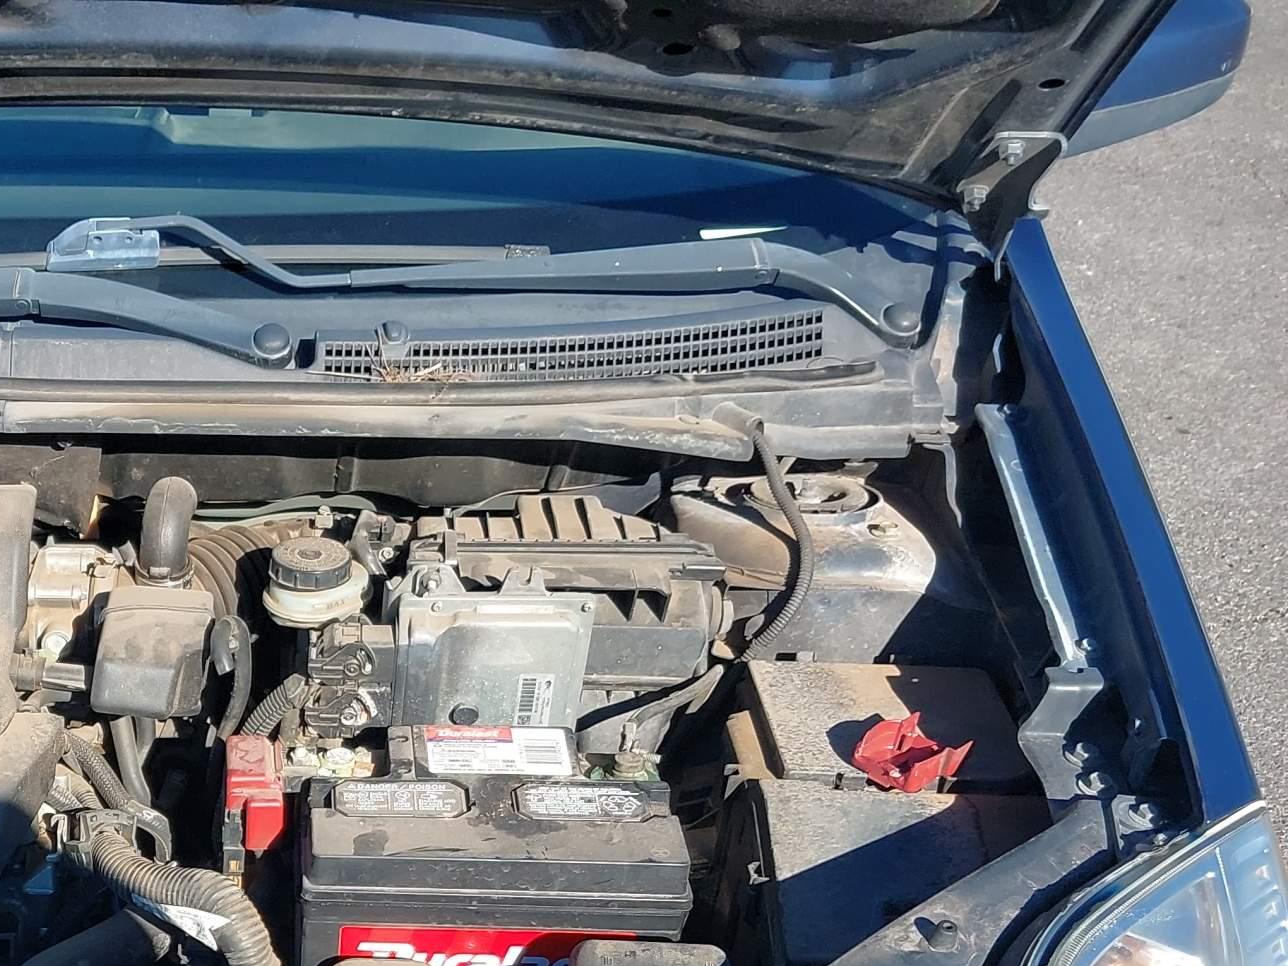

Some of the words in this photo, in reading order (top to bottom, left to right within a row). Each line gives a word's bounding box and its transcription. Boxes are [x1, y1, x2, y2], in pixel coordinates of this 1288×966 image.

[437, 728, 499, 738] Duralast
[356, 783, 398, 791] DANGER
[408, 783, 447, 791] POISON
